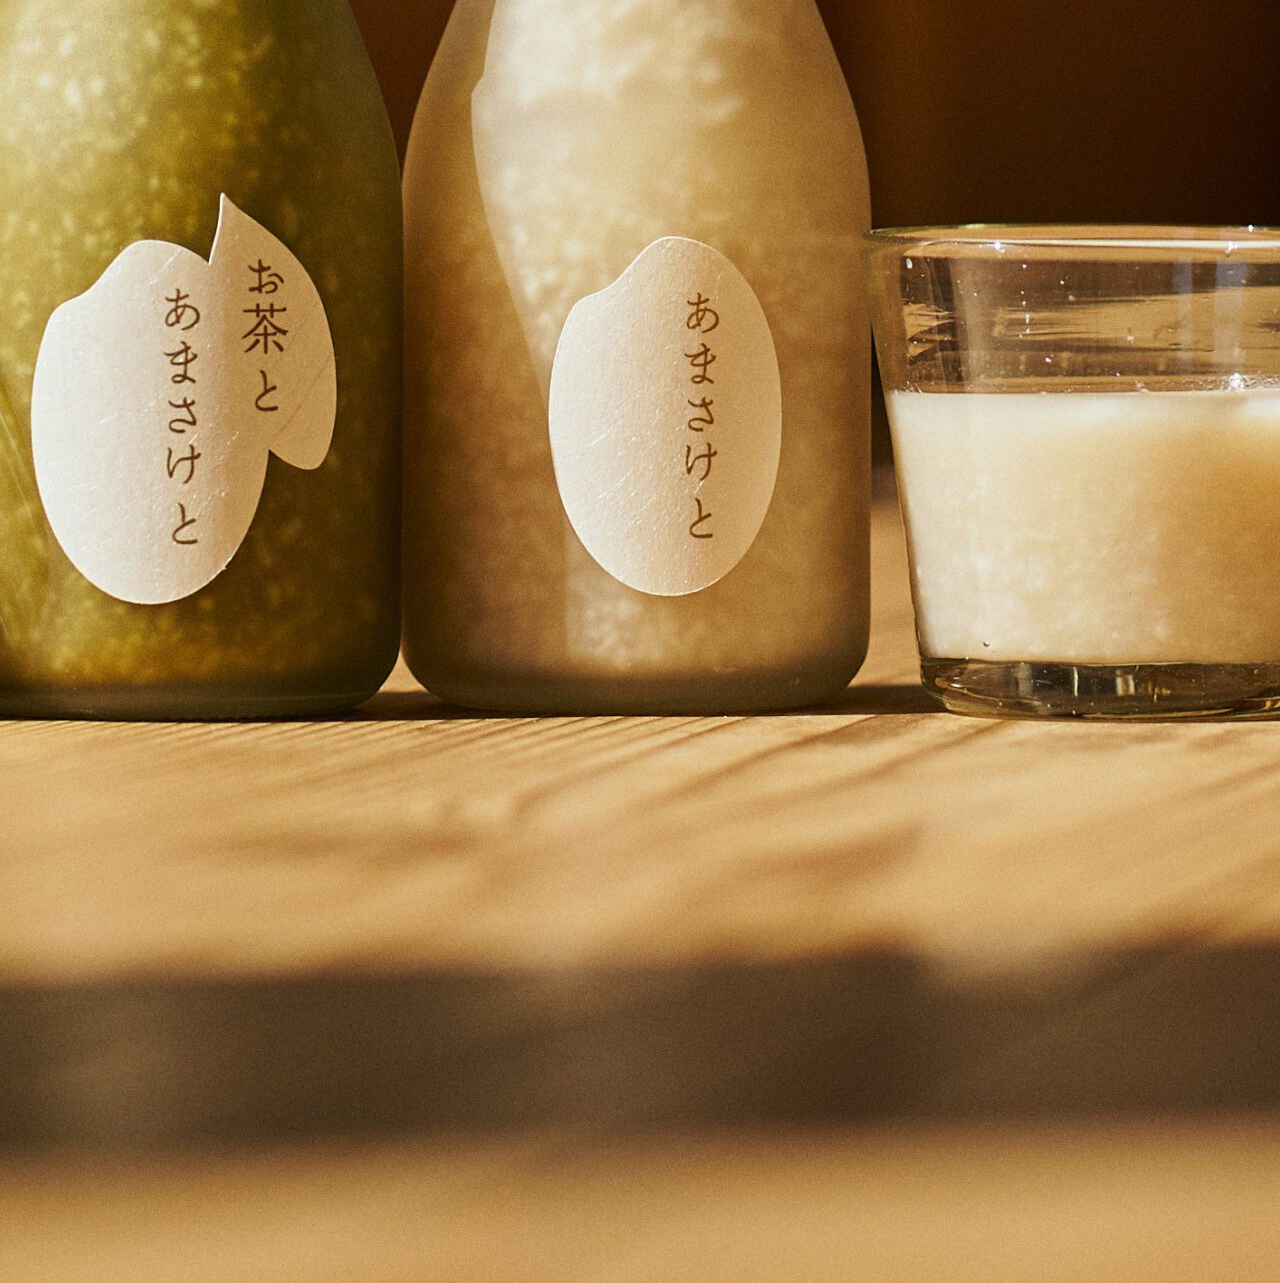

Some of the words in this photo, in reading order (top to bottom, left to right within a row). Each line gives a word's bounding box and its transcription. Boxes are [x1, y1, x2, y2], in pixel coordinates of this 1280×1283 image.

[164, 288, 202, 545] あまさけと
[242, 258, 289, 412] お茶と
[684, 292, 720, 539] あまさけと
